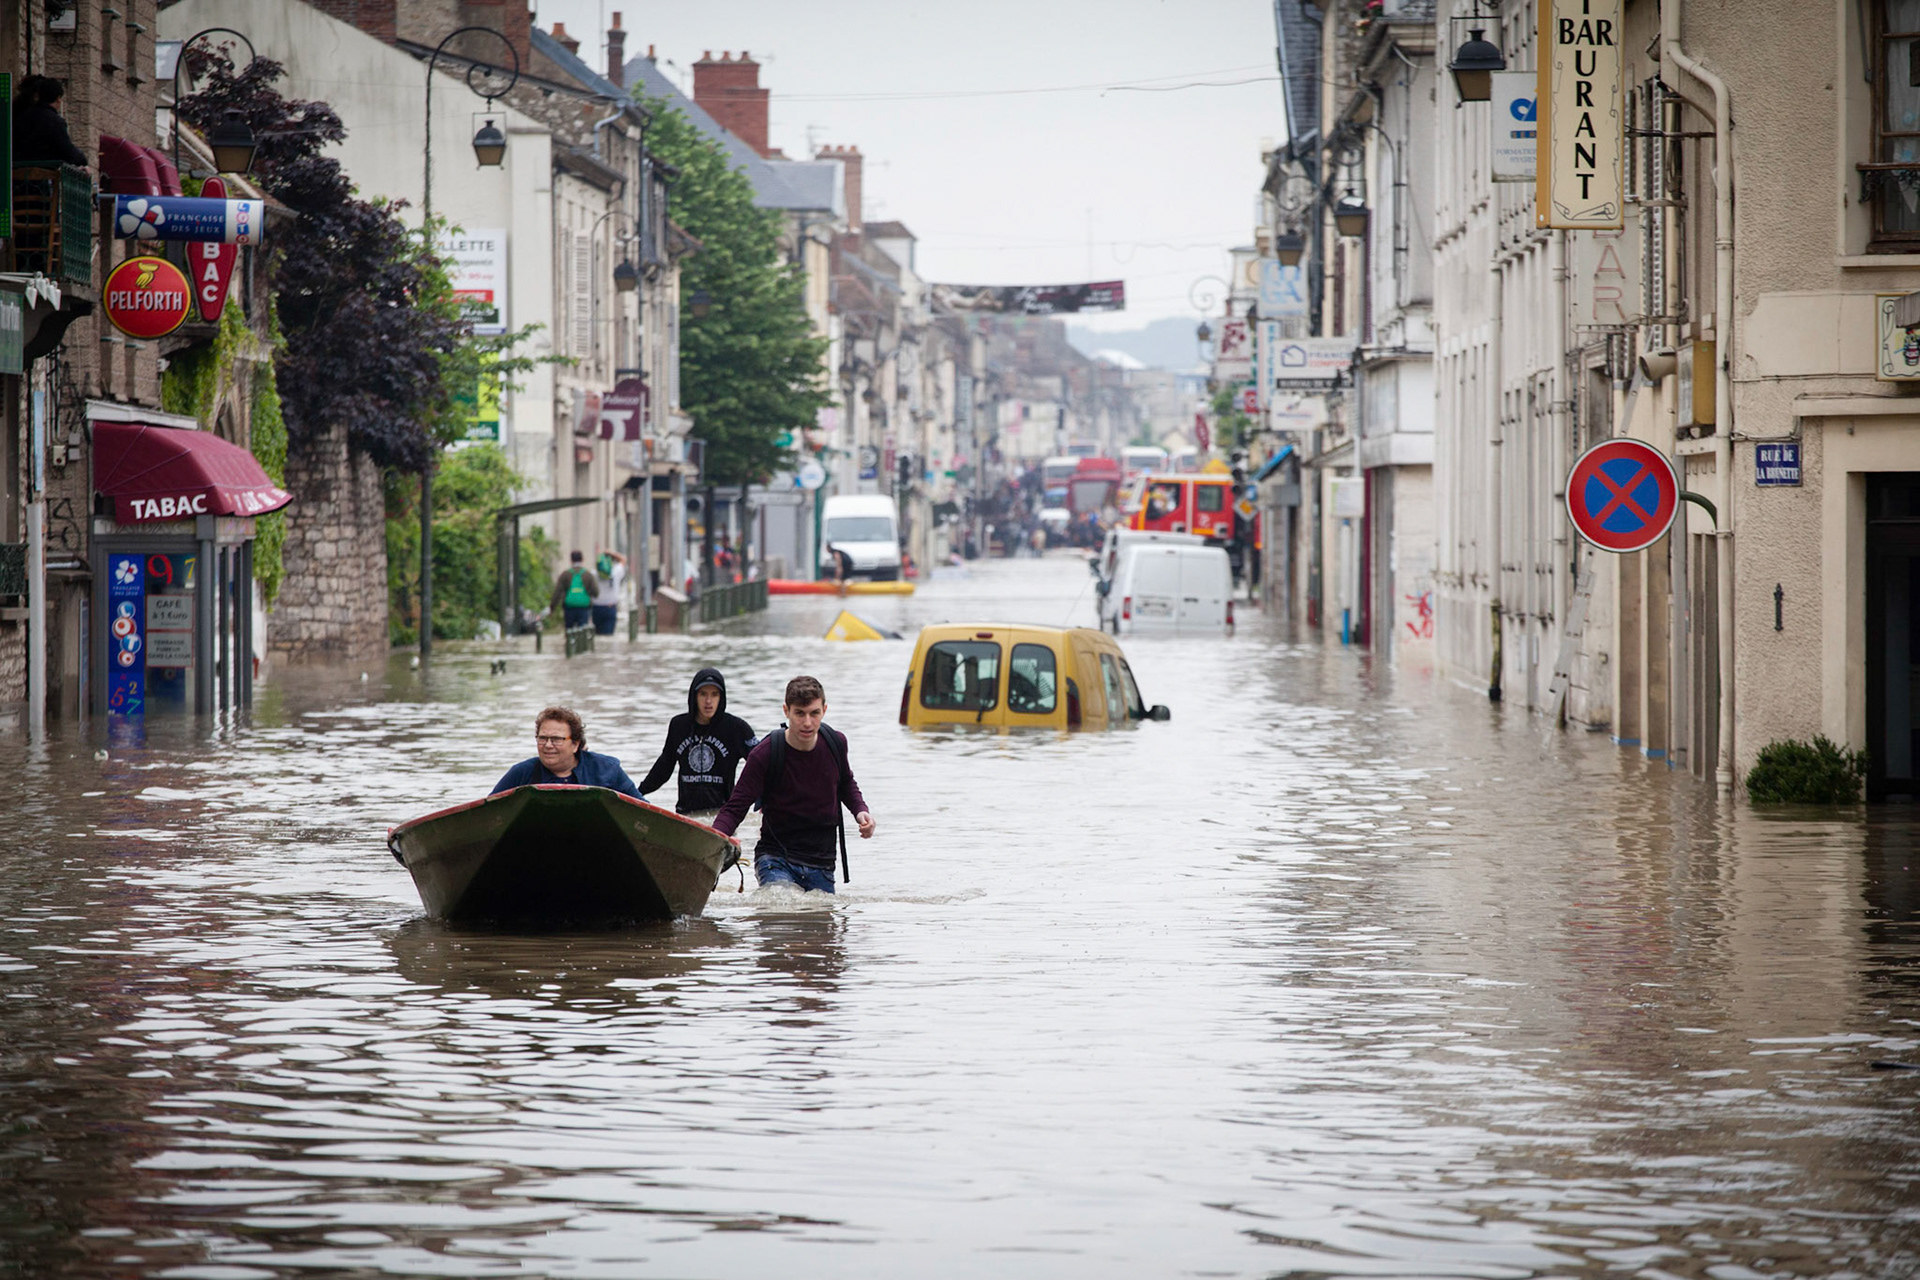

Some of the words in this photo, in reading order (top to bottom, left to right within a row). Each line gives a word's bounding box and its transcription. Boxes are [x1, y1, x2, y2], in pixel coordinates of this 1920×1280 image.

[1559, 18, 1614, 46] BAR
[167, 213, 225, 225] FRANÇAISE
[194, 225, 220, 233] JEUX
[109, 290, 183, 311] PELFORTH
[1760, 449, 1781, 462] RUE
[1783, 449, 1794, 462] DE
[1757, 467, 1766, 479] LA
[1767, 467, 1799, 479] BRUNETTE
[130, 493, 208, 520] TABAC
